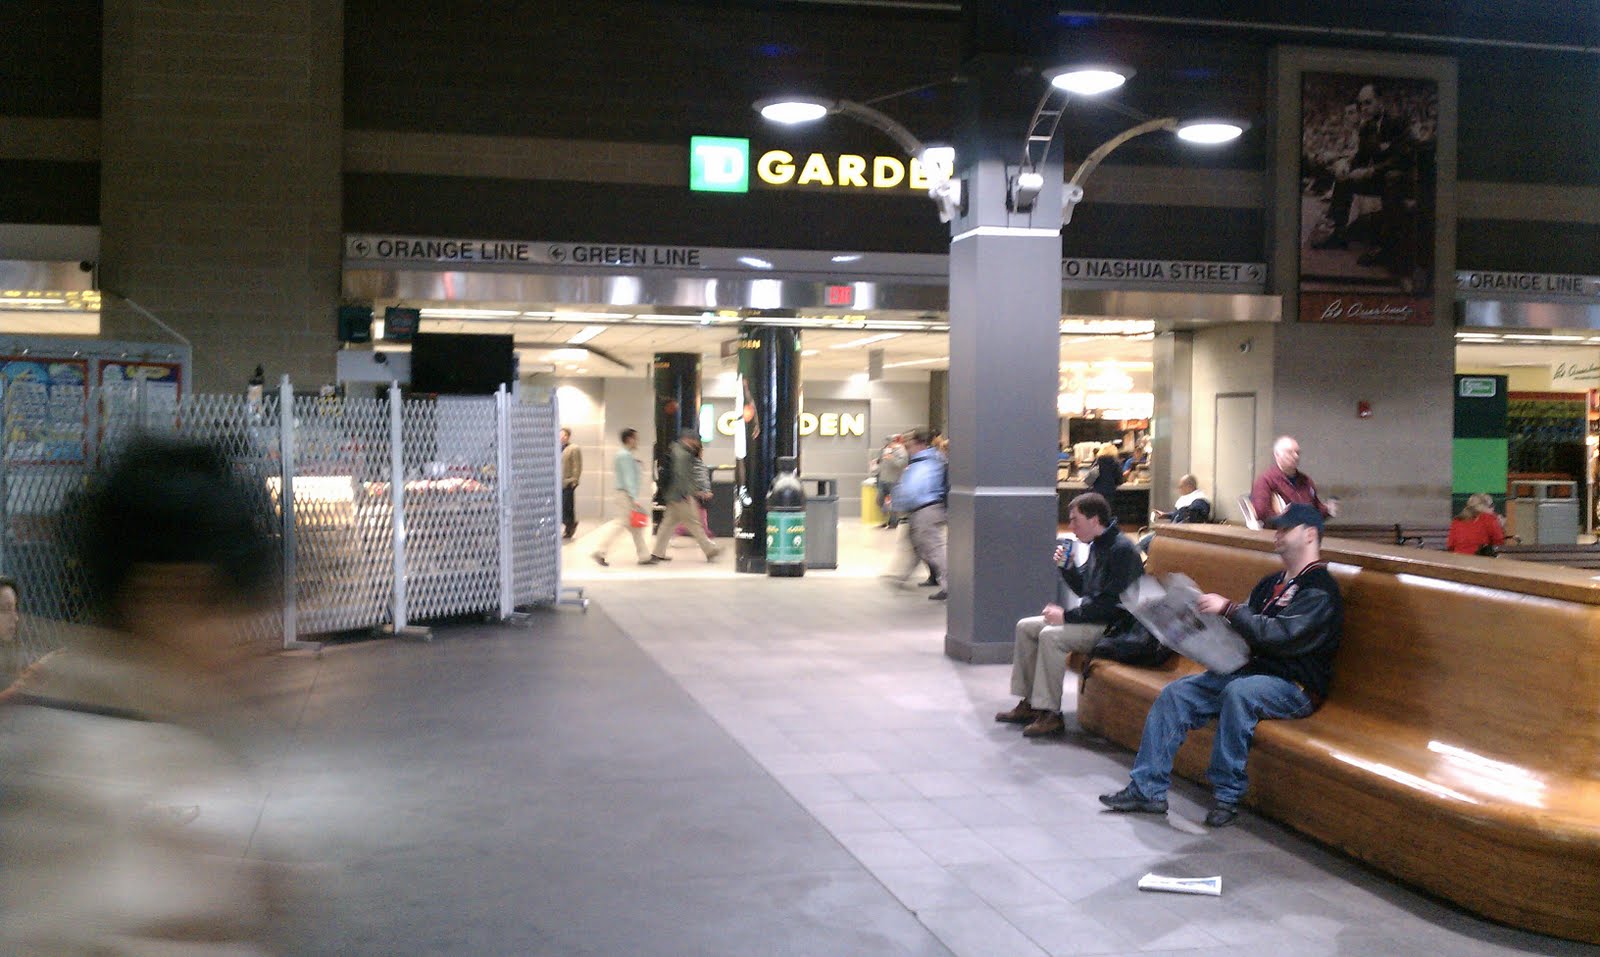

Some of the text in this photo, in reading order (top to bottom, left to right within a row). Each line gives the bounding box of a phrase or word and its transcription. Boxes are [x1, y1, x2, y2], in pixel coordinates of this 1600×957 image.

[696, 145, 953, 189] TD GARDE
[377, 240, 529, 260] ORANGE LINE
[572, 246, 700, 265] GREEN LINE
[1086, 261, 1165, 279] NASHUA
[1170, 263, 1241, 281] STREET
[1470, 273, 1583, 291] ORANGE LINE
